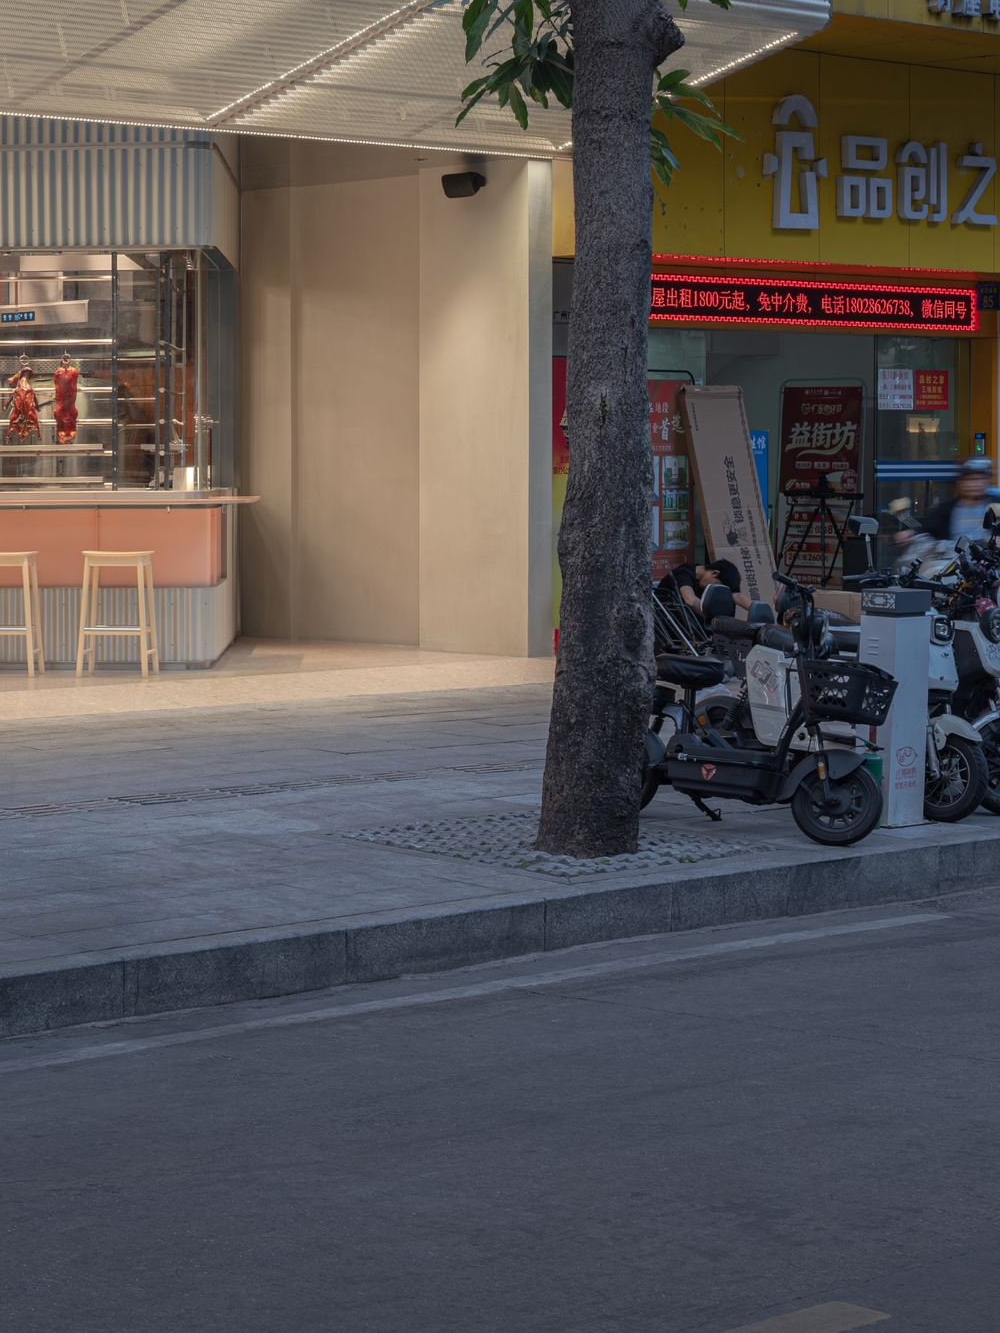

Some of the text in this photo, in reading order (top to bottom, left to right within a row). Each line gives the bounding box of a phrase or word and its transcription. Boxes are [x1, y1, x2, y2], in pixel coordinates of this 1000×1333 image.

[982, 295, 994, 308] 85
[785, 421, 857, 459] 益街坊
